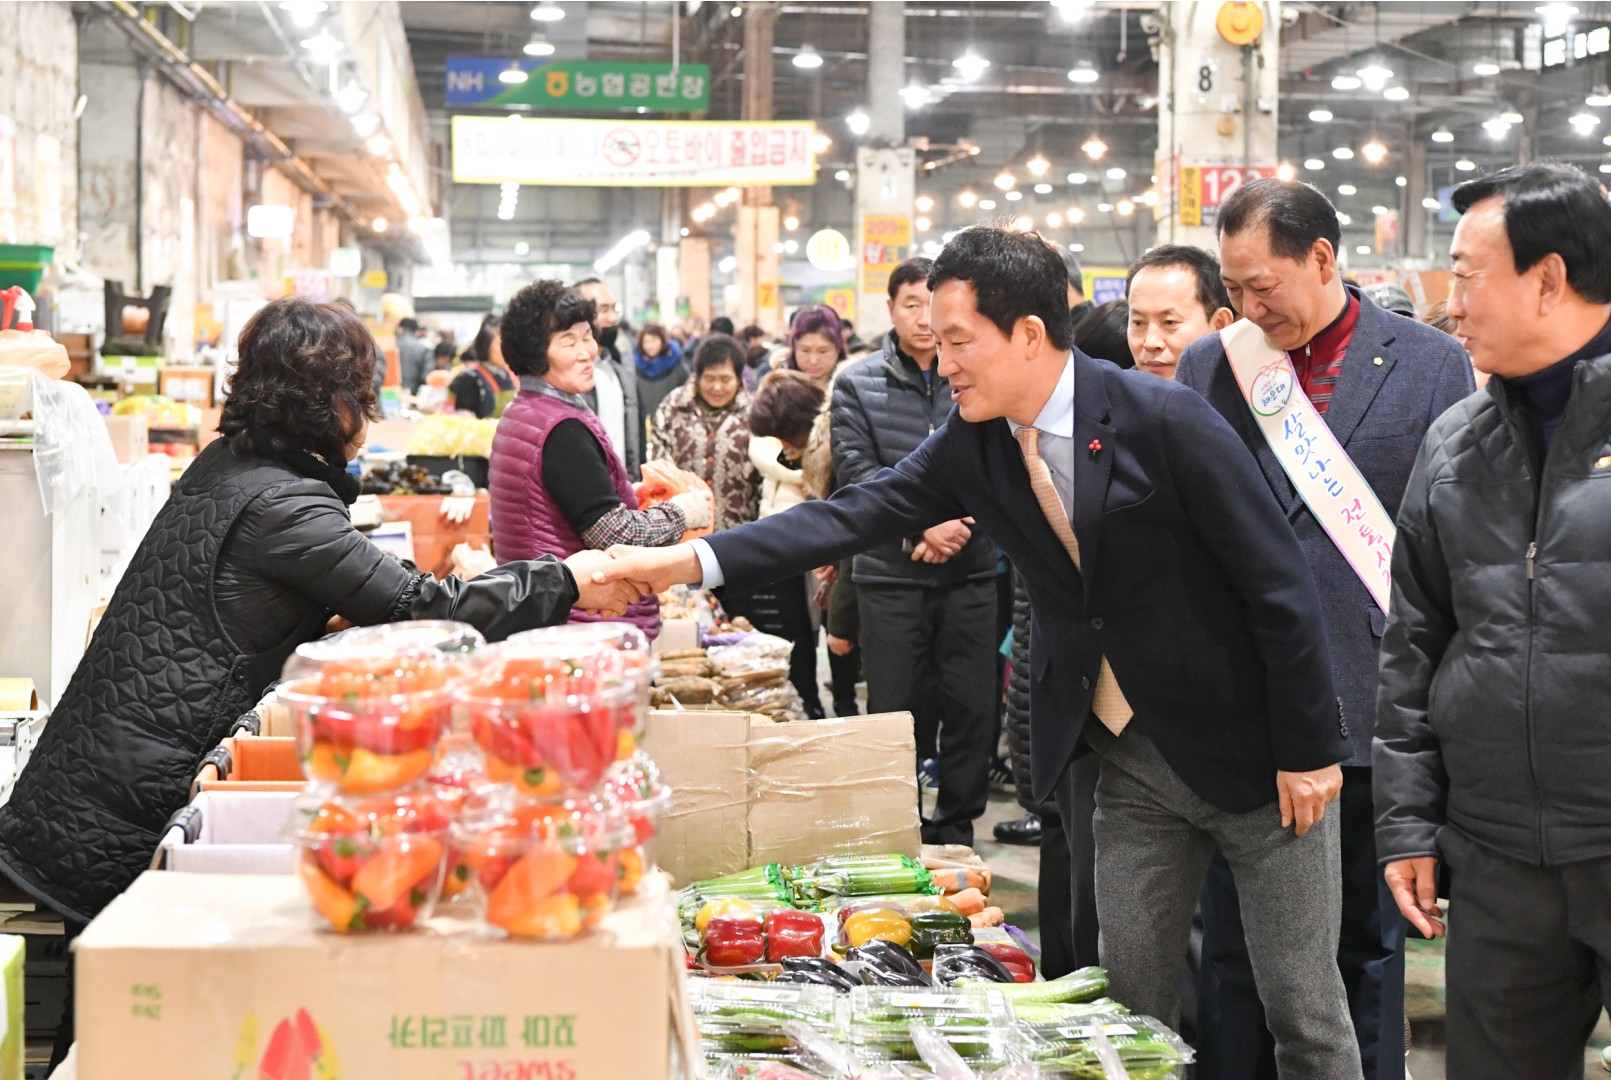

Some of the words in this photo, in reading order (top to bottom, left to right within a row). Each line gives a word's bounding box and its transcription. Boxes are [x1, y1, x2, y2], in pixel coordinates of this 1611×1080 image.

[447, 69, 483, 92] NH
[574, 72, 704, 100] 농협공판장
[1198, 65, 1213, 92] 8
[645, 129, 723, 167] 오토바이
[729, 128, 808, 168] 출입금지
[759, 283, 772, 304] 7
[832, 293, 848, 315] 9
[1261, 383, 1286, 407] 해운대
[388, 1014, 509, 1050] 파프리카
[521, 1014, 579, 1049] 꼬마
